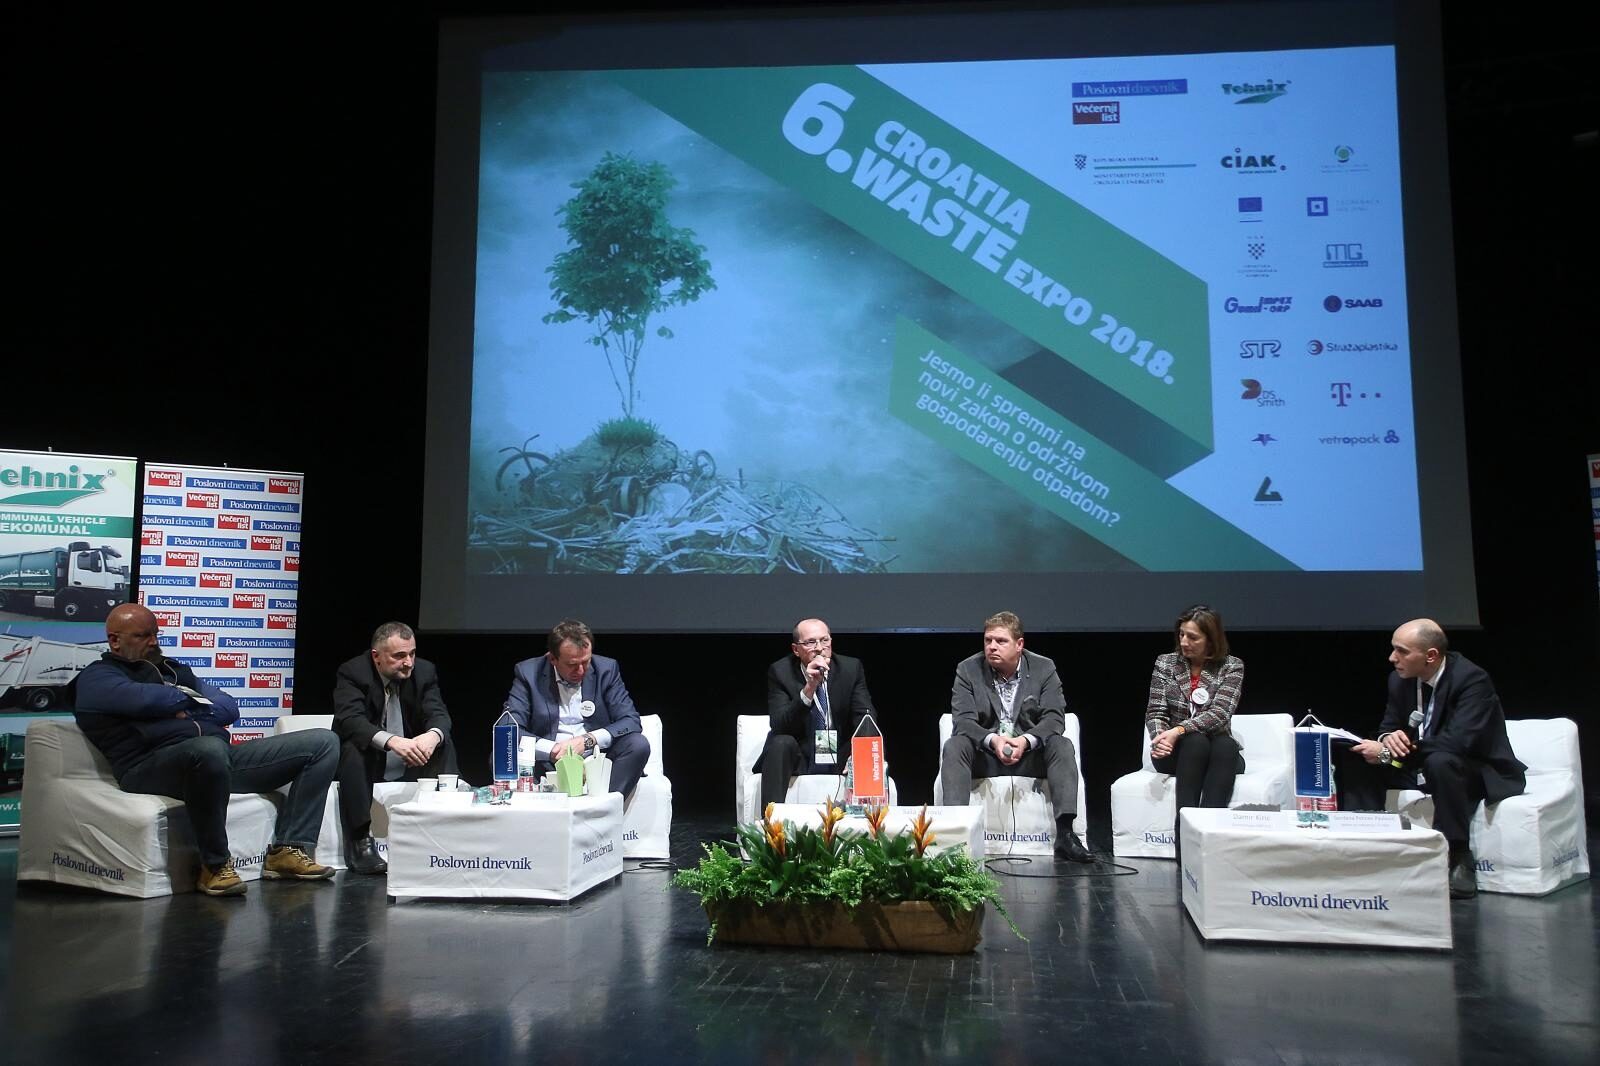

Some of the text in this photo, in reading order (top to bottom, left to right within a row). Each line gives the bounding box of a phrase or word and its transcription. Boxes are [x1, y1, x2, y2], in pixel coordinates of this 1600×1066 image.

[1082, 81, 1180, 97] Poslovni dnevnik
[1074, 103, 1118, 114] Večernji
[1101, 113, 1119, 122] list
[781, 82, 857, 173] 6.
[874, 120, 1031, 236] CROATIA
[850, 146, 1176, 386] WASTE EXPO 2018.
[1344, 298, 1383, 308] SAAB
[919, 350, 1087, 461] Jesmo li spremni na
[918, 371, 1110, 500] novi zakon o održivom
[1318, 434, 1380, 447] vetropack
[916, 393, 1121, 528] gospodarenju otpadom?
[0, 465, 105, 490] ehnix
[150, 471, 181, 482] Večernji
[193, 479, 260, 490] Poslovni dnevnik
[270, 479, 299, 488] Večernji
[188, 493, 218, 503] Večernji
[230, 501, 294, 512] Poslovni dnevnik
[0, 513, 107, 525] MMUNAL VEHICLE
[175, 517, 209, 527] dnevnik
[219, 515, 249, 524] Večernji
[260, 522, 292, 531] Poslovni
[174, 537, 241, 548] Poslovni dnevnik
[252, 536, 282, 545] Večernji
[167, 552, 198, 561] Večernji
[210, 558, 275, 569] Poslovni dnevnik
[156, 577, 190, 586] dnevnik
[201, 573, 231, 582] Večernji
[243, 579, 275, 589] Poslovni
[155, 597, 190, 607] Poslovni
[190, 598, 223, 607] dnevnik
[235, 594, 264, 603] Večernji
[191, 618, 259, 628] Poslovni dnevnik
[184, 632, 214, 641] Večernji
[201, 639, 214, 647] list
[225, 639, 290, 648] Poslovni dnevnik
[217, 653, 247, 662] Večernji
[258, 659, 290, 668] Poslovni
[207, 678, 240, 687] dnevnik
[251, 673, 280, 682] Večernji
[268, 680, 280, 688] list
[241, 698, 273, 707] dnevnik
[240, 719, 273, 727] Poslovni
[984, 831, 1051, 842] lovni dnevnik
[1144, 832, 1176, 845] Poslov
[232, 851, 266, 869] dnevni
[429, 854, 532, 871] Poslovni dnevnik
[51, 851, 125, 882] Poslovni dnevnik
[1251, 890, 1389, 911] Poslovni dnevnik
